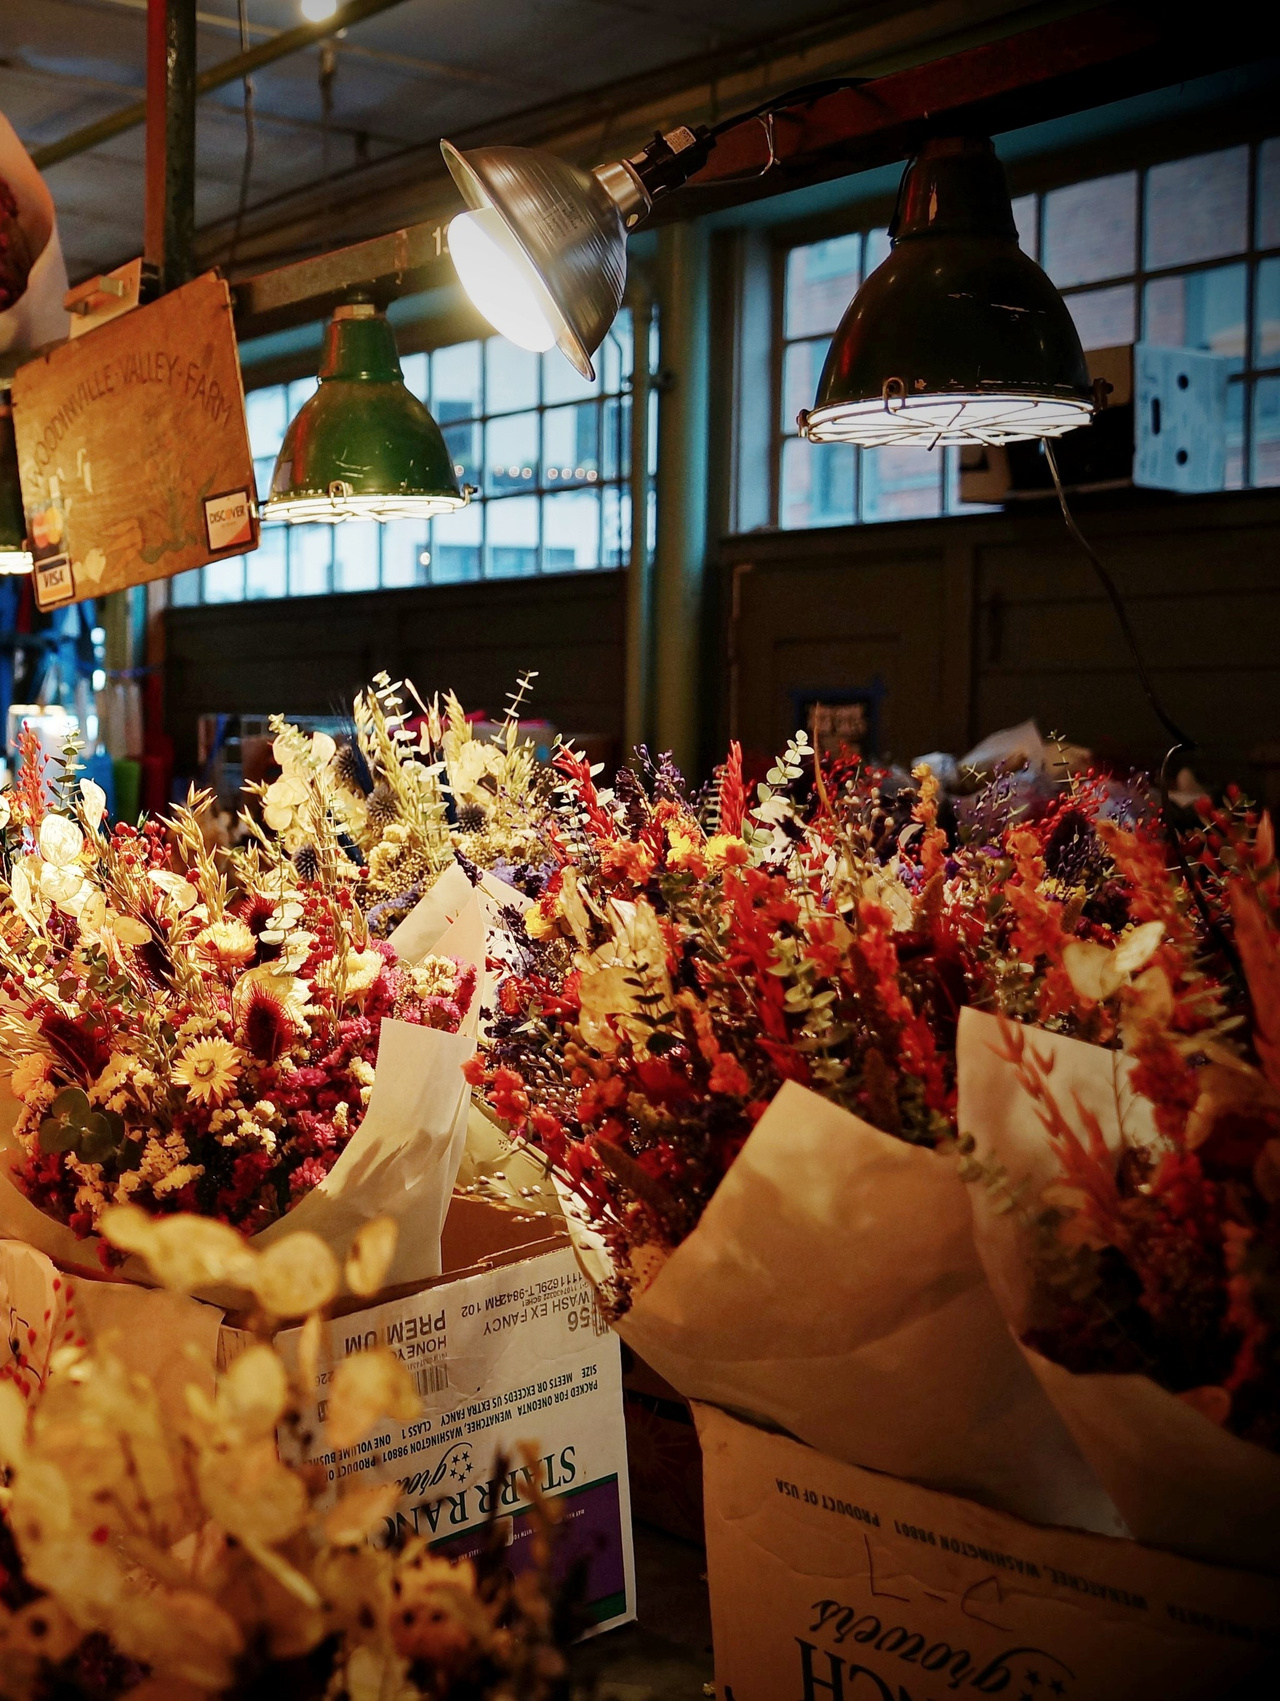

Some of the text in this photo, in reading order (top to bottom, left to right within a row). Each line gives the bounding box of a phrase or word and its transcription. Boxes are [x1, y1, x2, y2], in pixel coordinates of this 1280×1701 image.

[432, 223, 450, 257] 1
[119, 351, 180, 386] VALLEY
[43, 569, 64, 588] VISA
[461, 1302, 482, 1318] 102
[482, 1290, 590, 1336] WASH EX FANCY
[567, 1307, 591, 1332] 56
[344, 1309, 446, 1357] PREMUM
[549, 1372, 573, 1390] MEETS
[581, 1364, 598, 1379] SIZE
[503, 1385, 536, 1405] EXCEEDS
[536, 1380, 548, 1393] OR
[553, 1389, 569, 1404] FOR
[570, 1380, 598, 1398] PACKED
[467, 1399, 491, 1419] EXTRA
[492, 1396, 503, 1408] US
[516, 1396, 553, 1417] ONEONTA
[440, 1408, 465, 1427] FANCY
[463, 1409, 513, 1434] WENATCHEE,
[401, 1429, 406, 1440] 1
[408, 1420, 432, 1438] CLASS
[338, 1440, 373, 1460] VOLUME
[373, 1434, 391, 1449] ONE
[410, 1426, 463, 1454] WASHINGTON
[382, 1445, 409, 1463] 98801
[336, 1456, 376, 1479] PRODUCT
[473, 1446, 576, 1514] STARR
[775, 1478, 800, 1500] USA
[803, 1489, 818, 1506] OF
[821, 1495, 881, 1528] PRODUCT
[894, 1520, 937, 1546] 98801
[939, 1534, 1040, 1580] WASHINGTON
[809, 1600, 1076, 1693] growers
